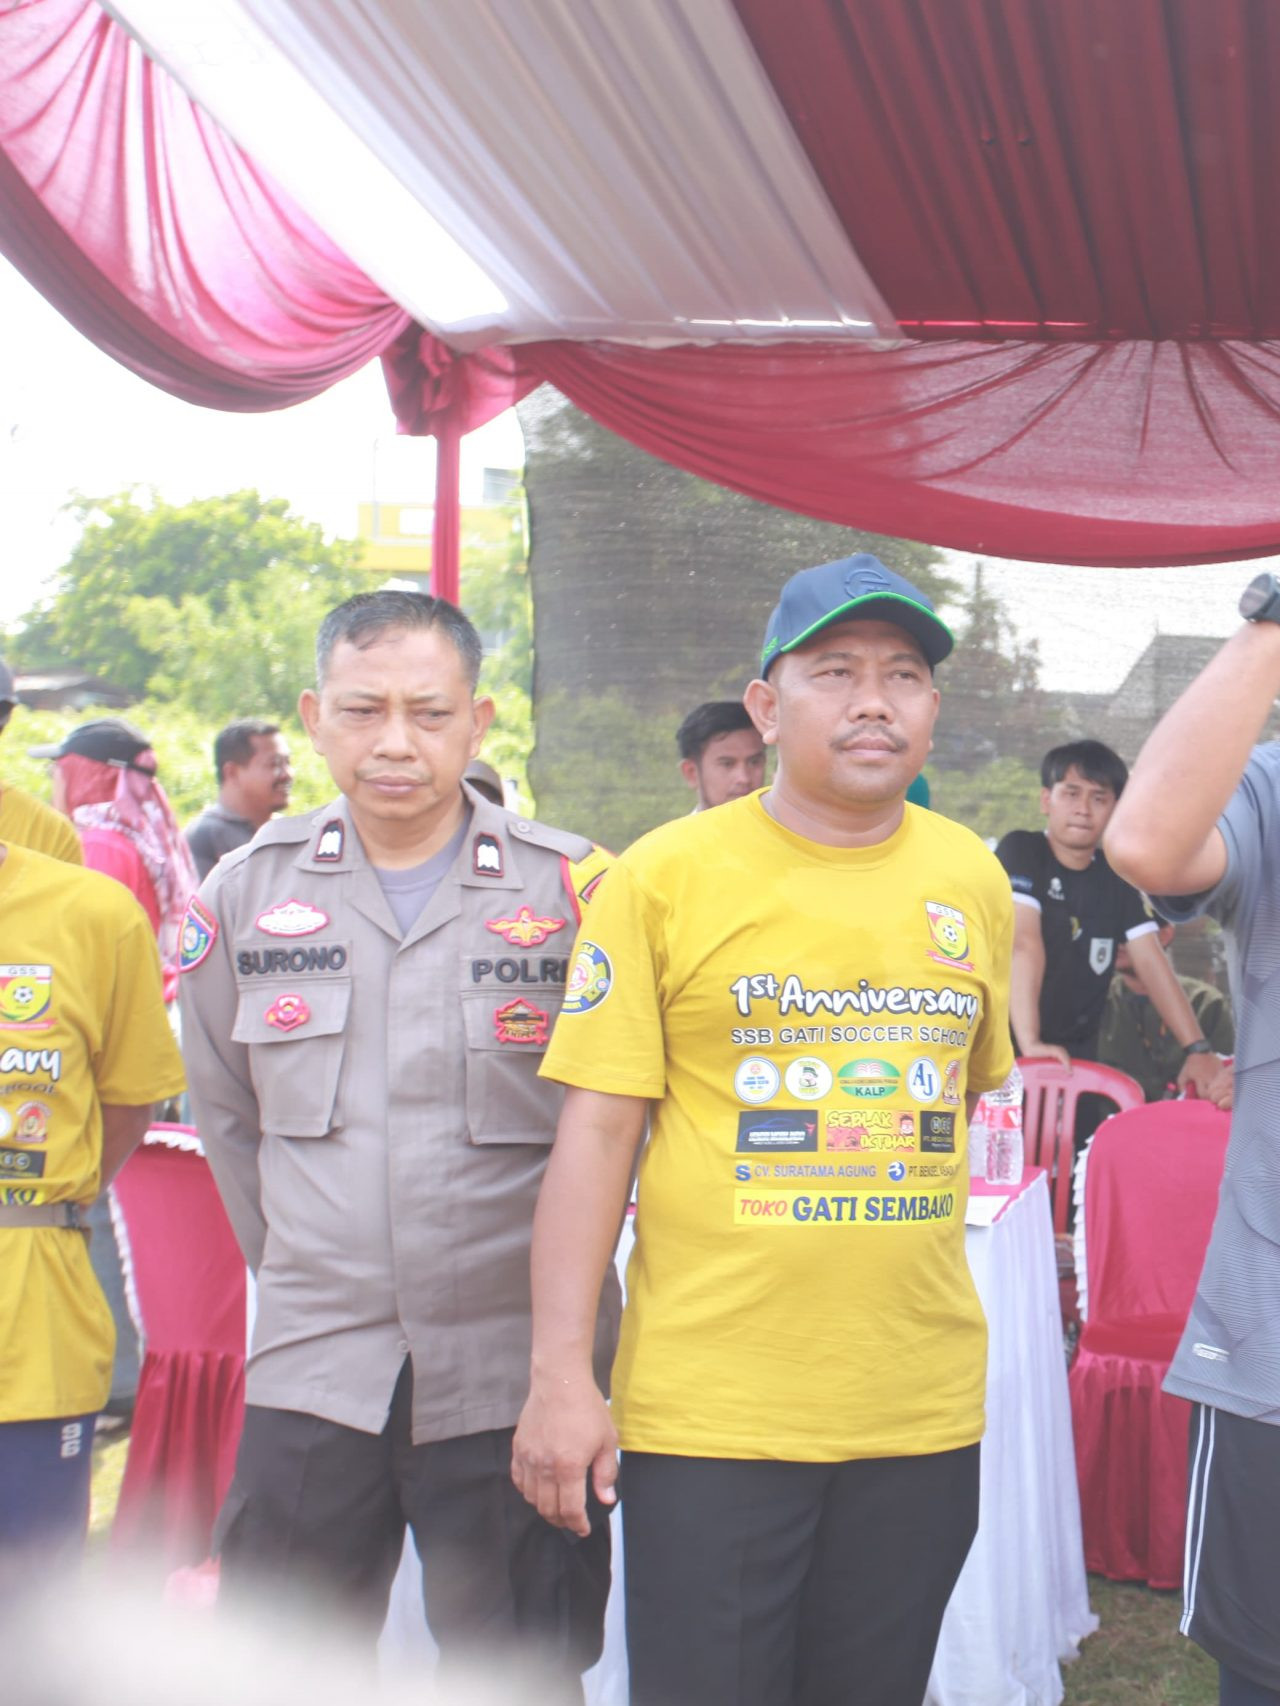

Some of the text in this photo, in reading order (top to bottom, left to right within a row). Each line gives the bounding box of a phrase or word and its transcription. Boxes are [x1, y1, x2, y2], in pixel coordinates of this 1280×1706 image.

[237, 945, 347, 975] SURONO
[779, 974, 978, 1031] Anniversary
[731, 1025, 968, 1048] SSB GATI SOCCER SCHOOL
[855, 1086, 886, 1097] KALP
[774, 1165, 835, 1178] SURATAMA
[838, 1165, 877, 1178] AGUNG
[740, 1192, 954, 1222] TOKO GATI SEMBAKO
